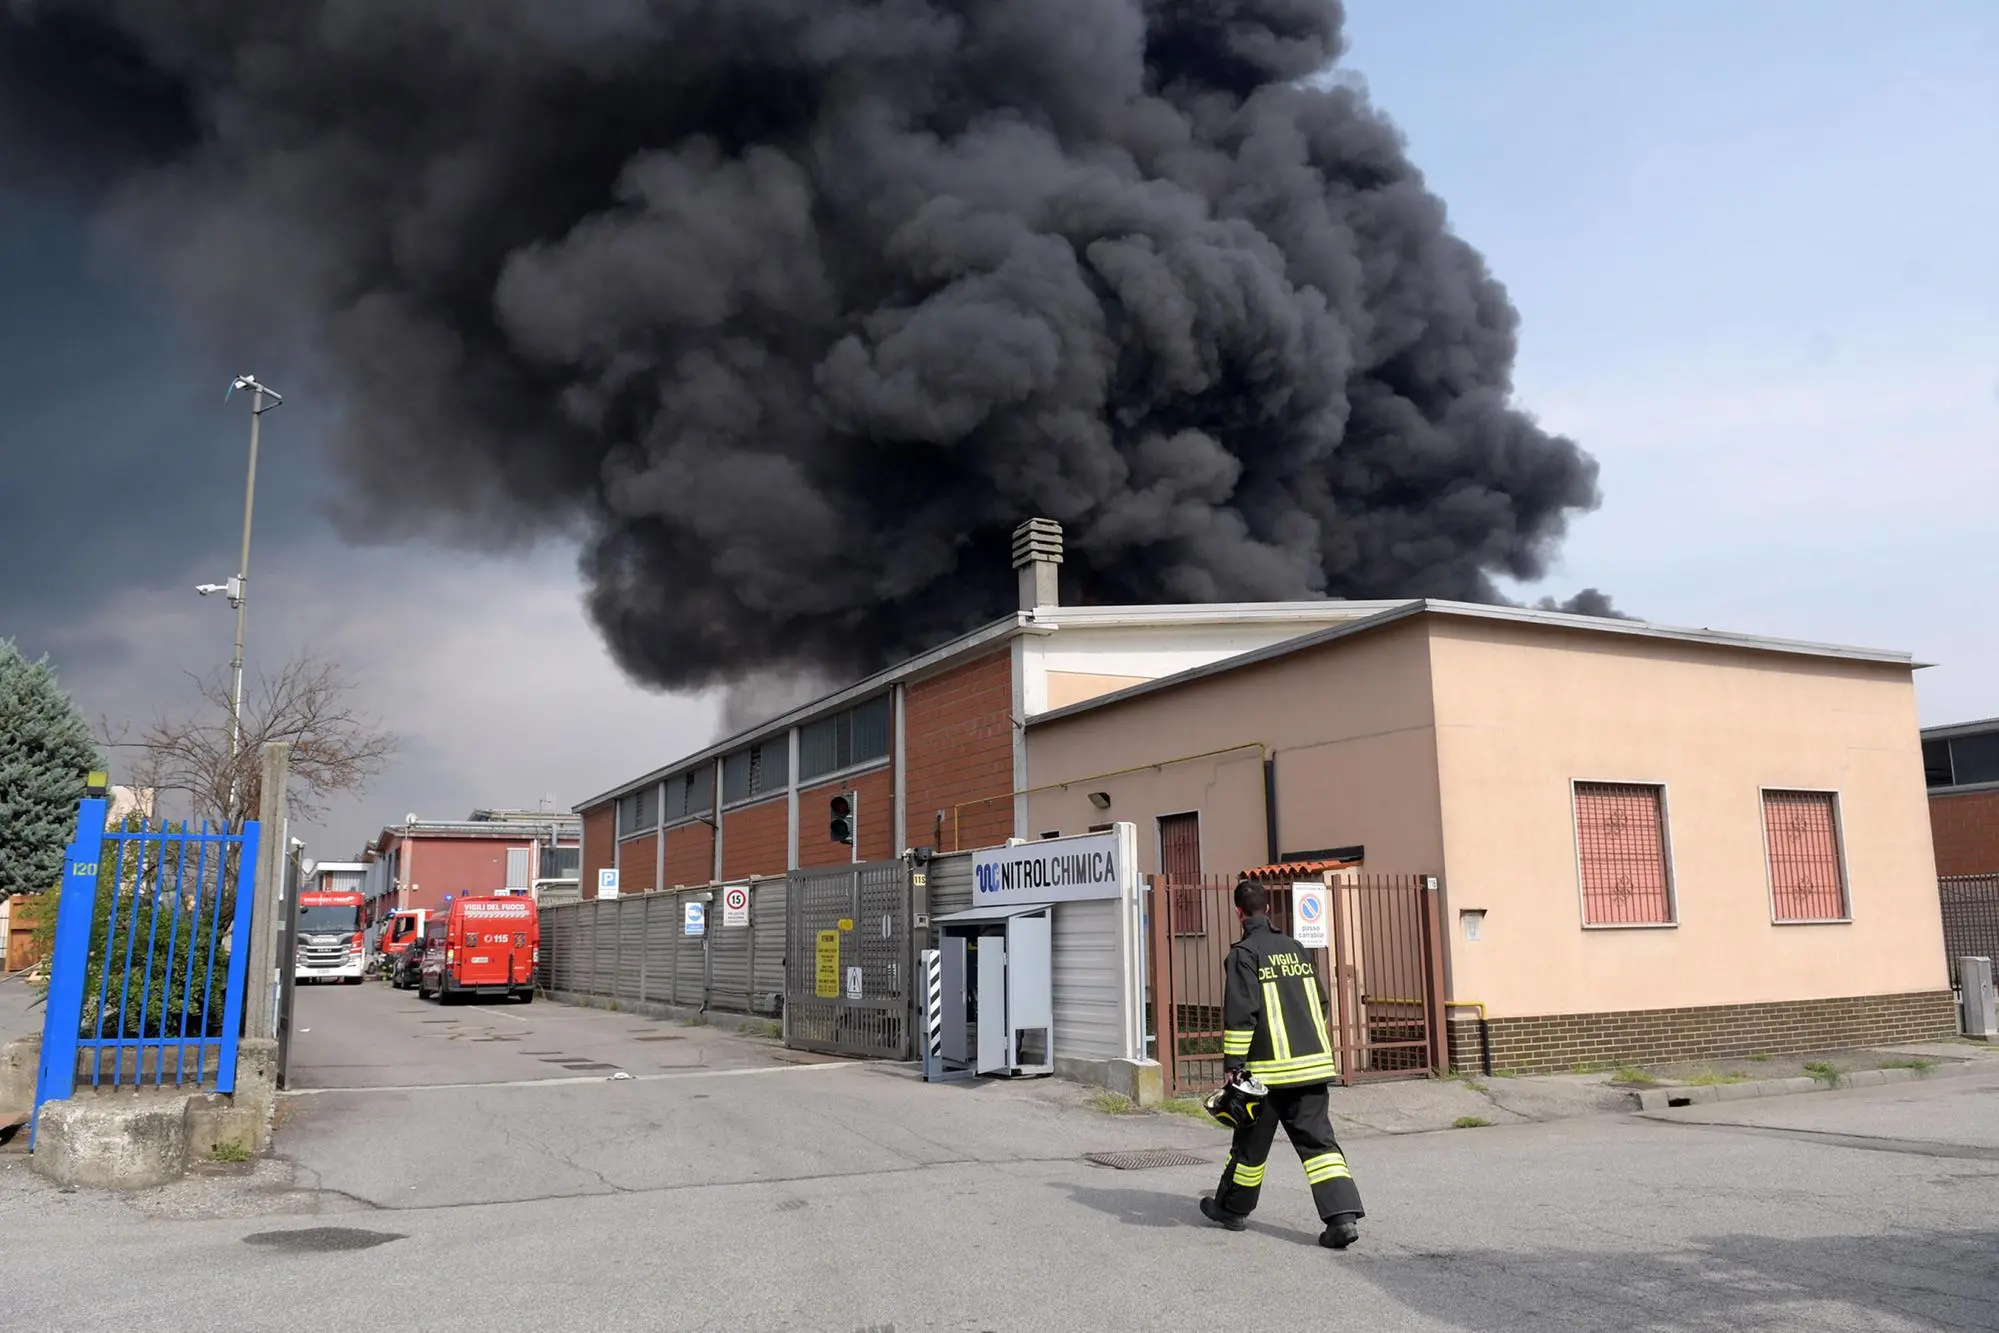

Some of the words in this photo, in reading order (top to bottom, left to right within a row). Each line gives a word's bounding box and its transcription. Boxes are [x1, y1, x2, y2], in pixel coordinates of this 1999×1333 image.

[73, 863, 98, 876] 120
[1001, 851, 1115, 890] NITROLCHIMICA
[731, 894, 741, 904] 15
[494, 934, 509, 942] 115
[1268, 952, 1299, 966] VIGILI
[1258, 967, 1278, 980] DEL
